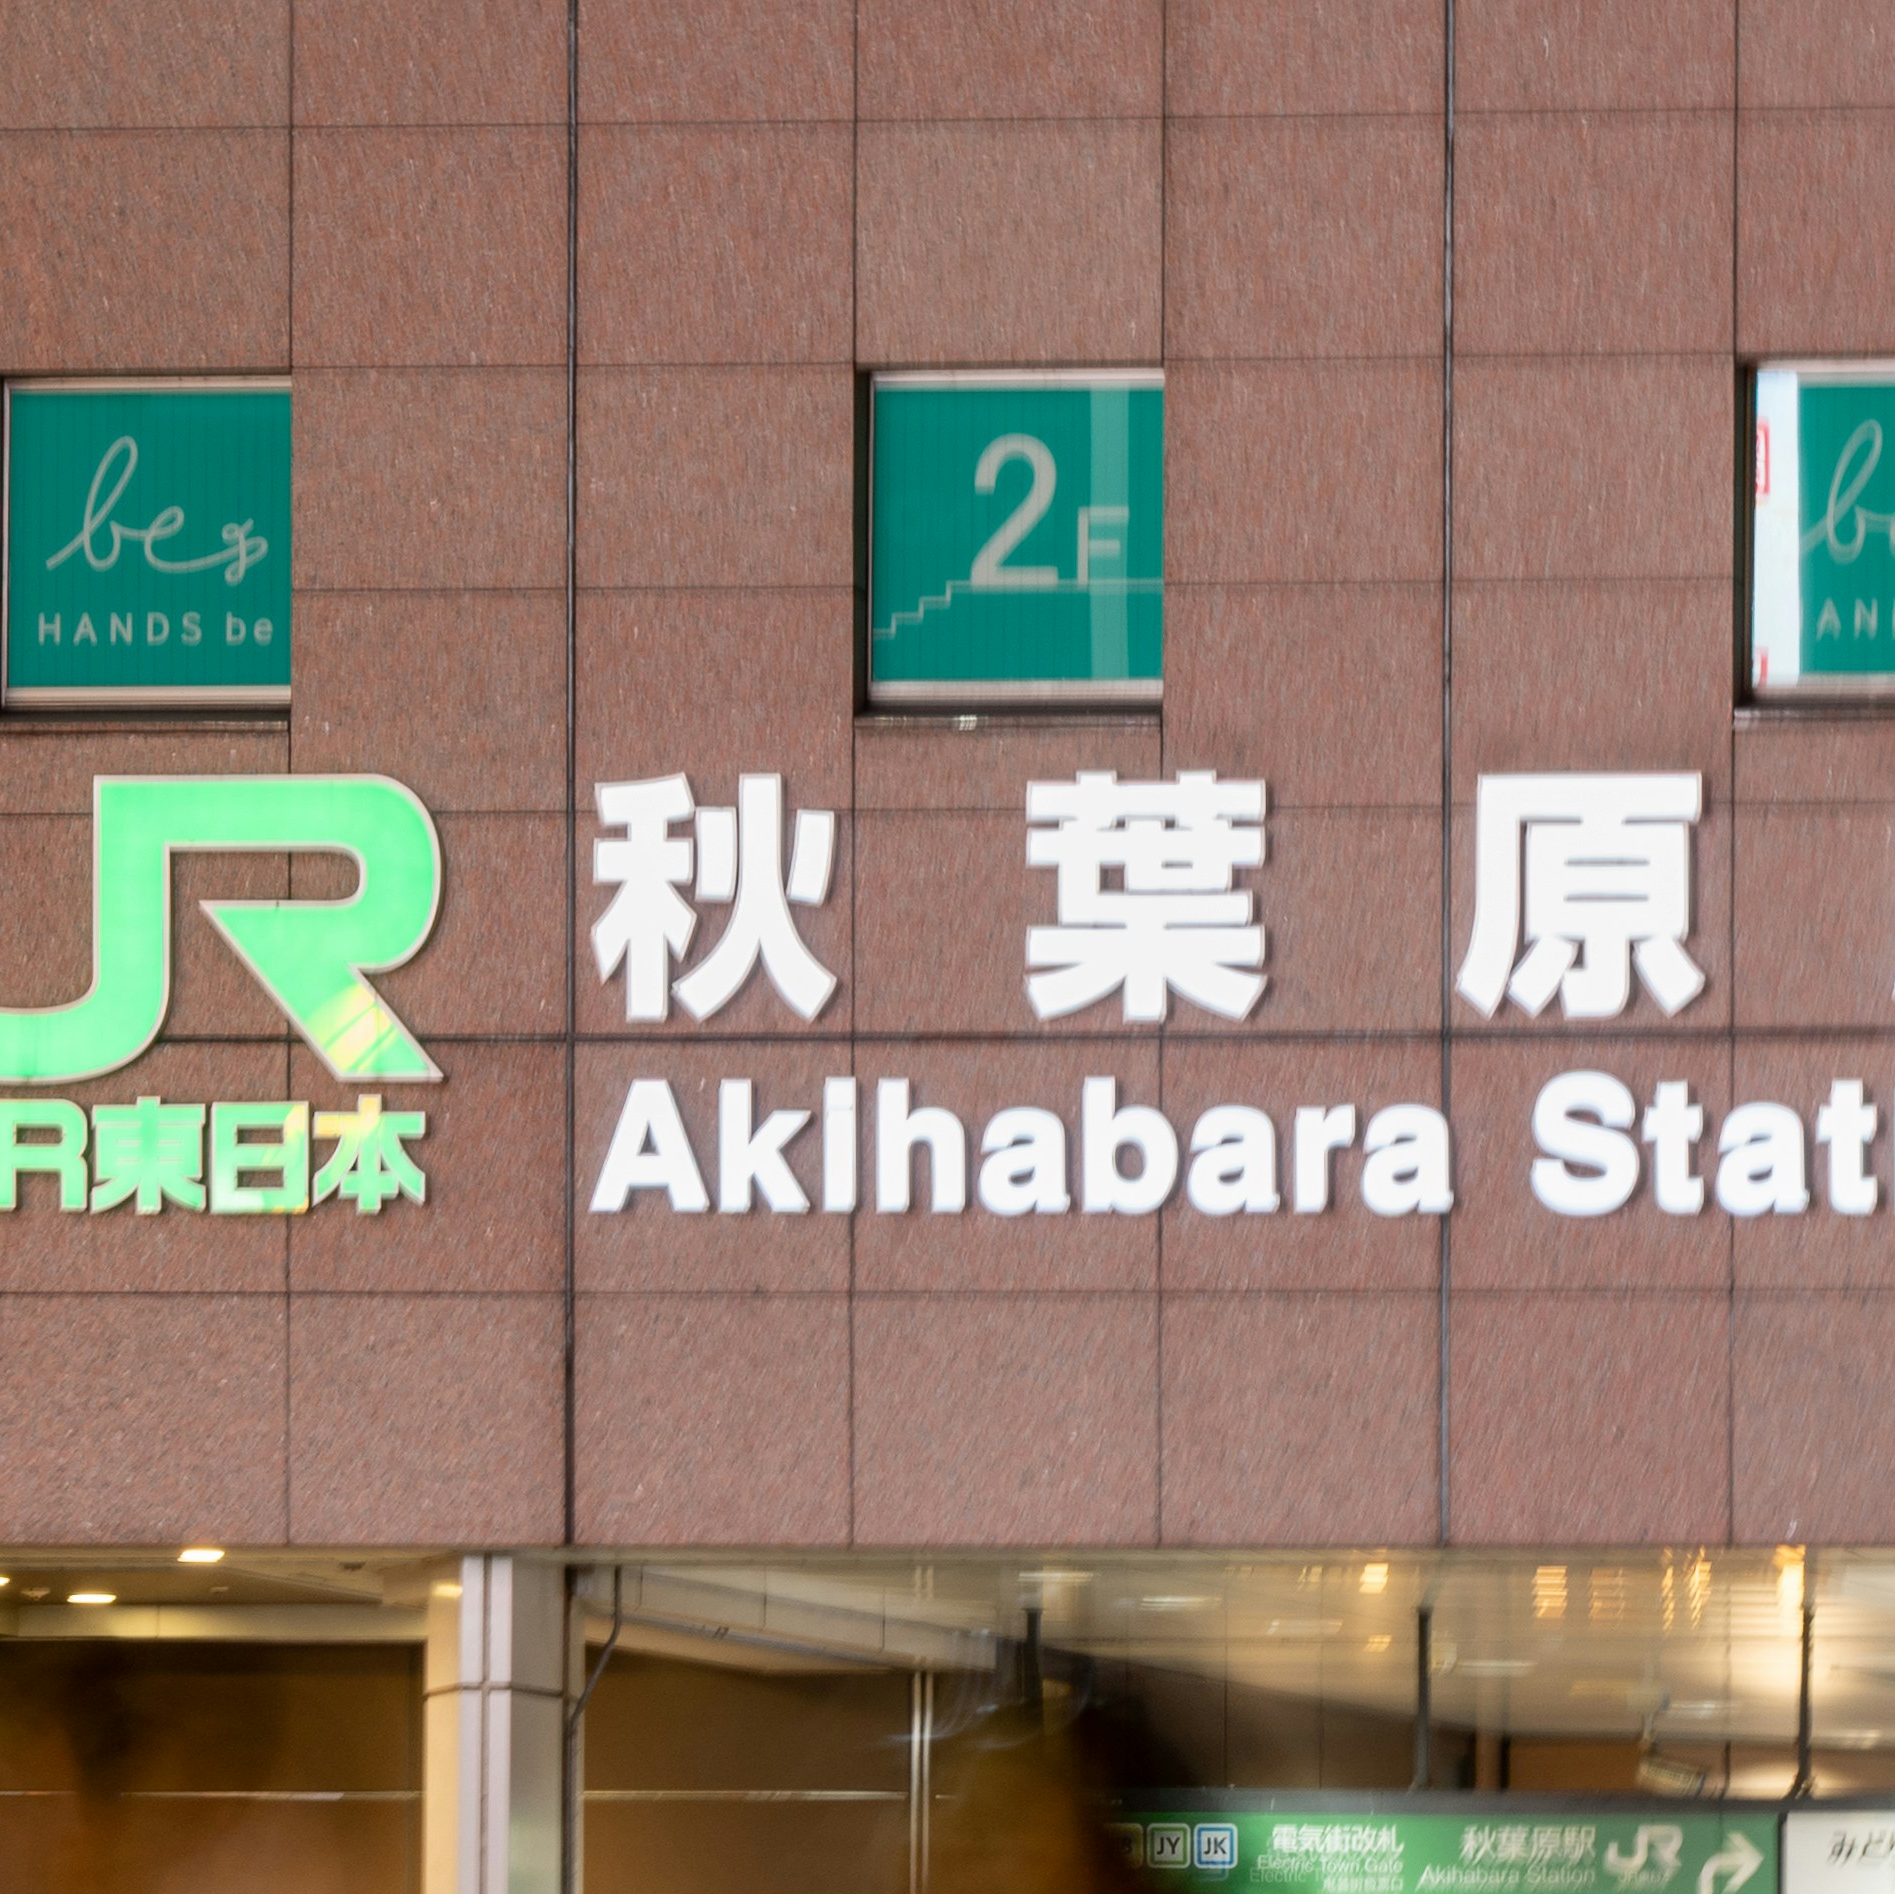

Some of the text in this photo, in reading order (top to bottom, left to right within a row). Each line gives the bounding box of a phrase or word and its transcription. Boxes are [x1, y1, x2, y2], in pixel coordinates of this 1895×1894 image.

[969, 432, 1130, 592] 2F
[38, 611, 274, 647] HANDS be
[590, 1074, 1454, 1217] Akihabara
[1156, 1837, 1180, 1855] JY
[1204, 1837, 1226, 1855] JK
[1273, 1823, 1405, 1853] 電気街改札
[1460, 1823, 1598, 1864] 秋葉原駅
[1605, 1824, 1684, 1875] JR
[1257, 1854, 1404, 1875] Electric Town Gate
[1417, 1863, 1597, 1887] Akihabara Station
